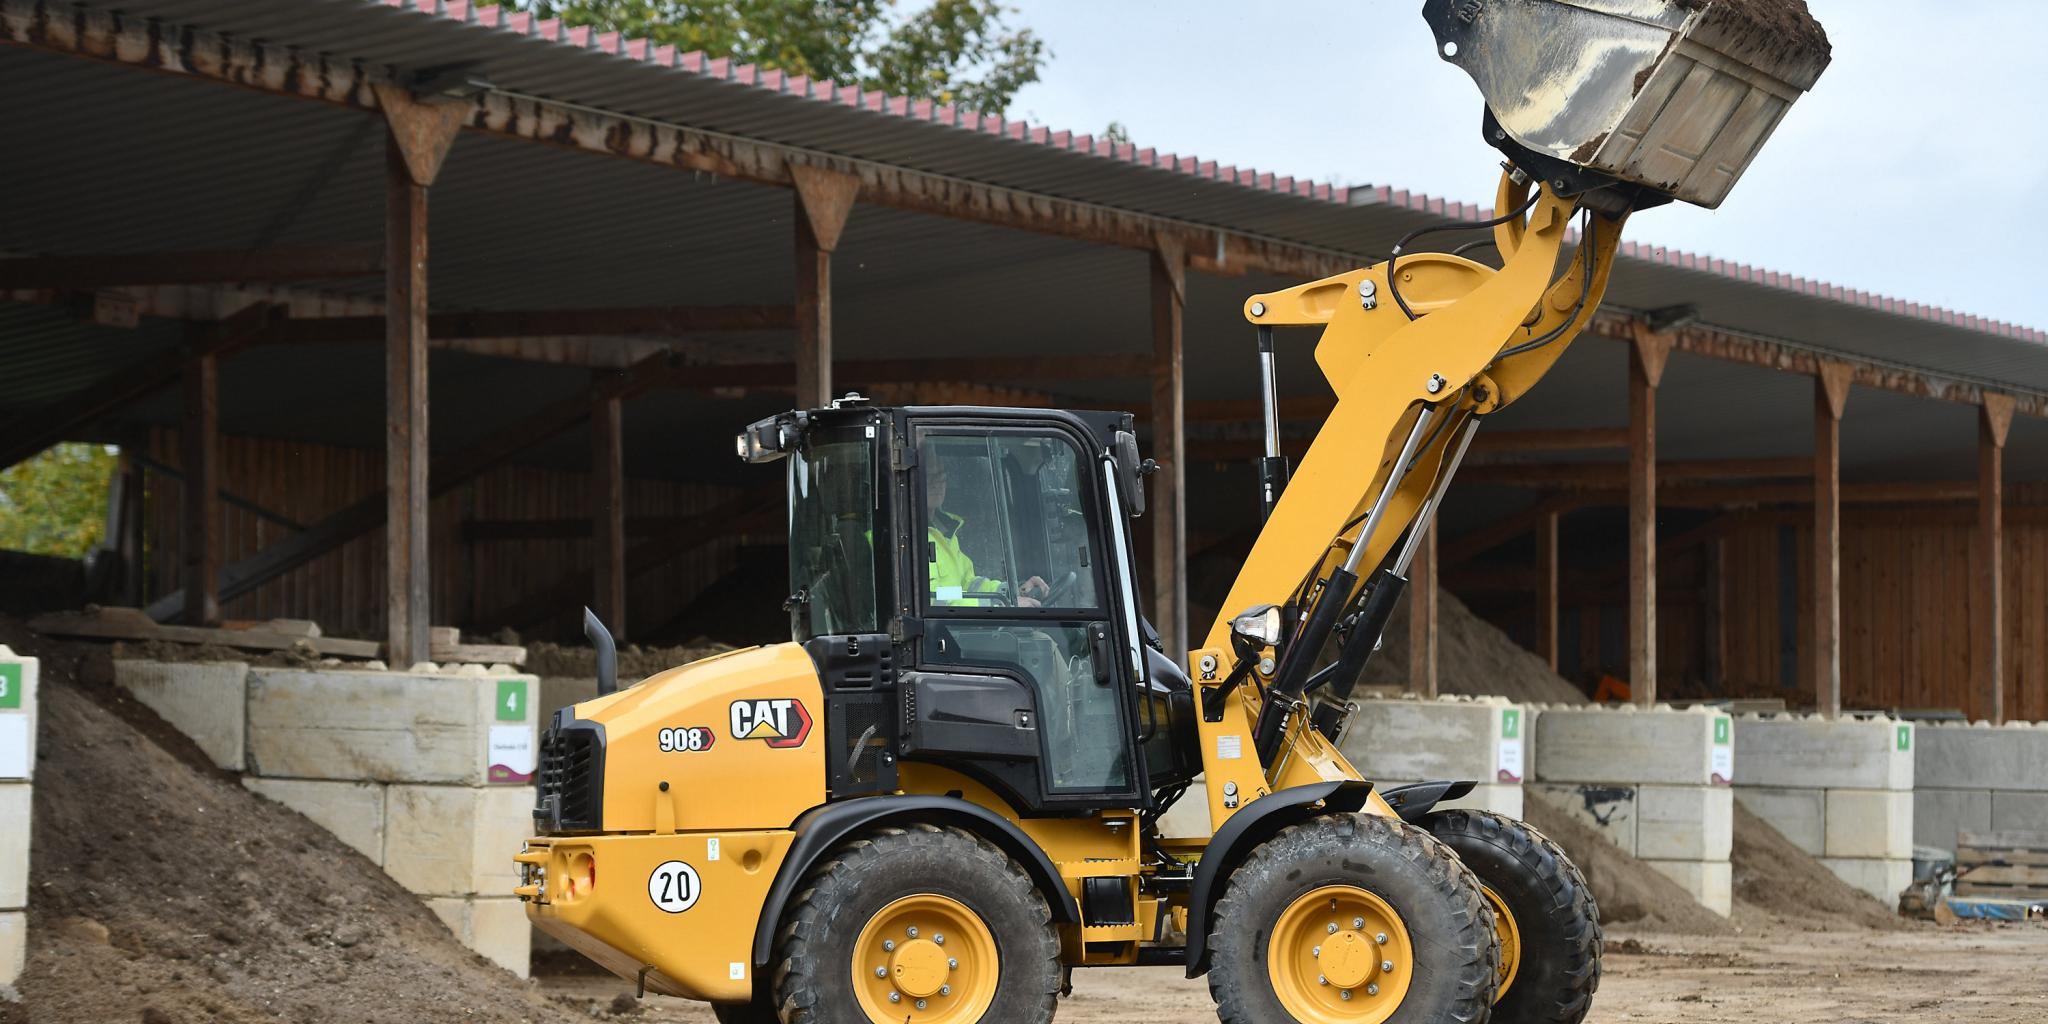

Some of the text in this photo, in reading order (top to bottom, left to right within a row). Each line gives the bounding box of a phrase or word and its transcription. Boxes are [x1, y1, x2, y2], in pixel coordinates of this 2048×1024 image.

[506, 691, 517, 712] 4
[730, 700, 792, 739] CAT
[659, 727, 702, 751] 908
[659, 870, 691, 903] 20
